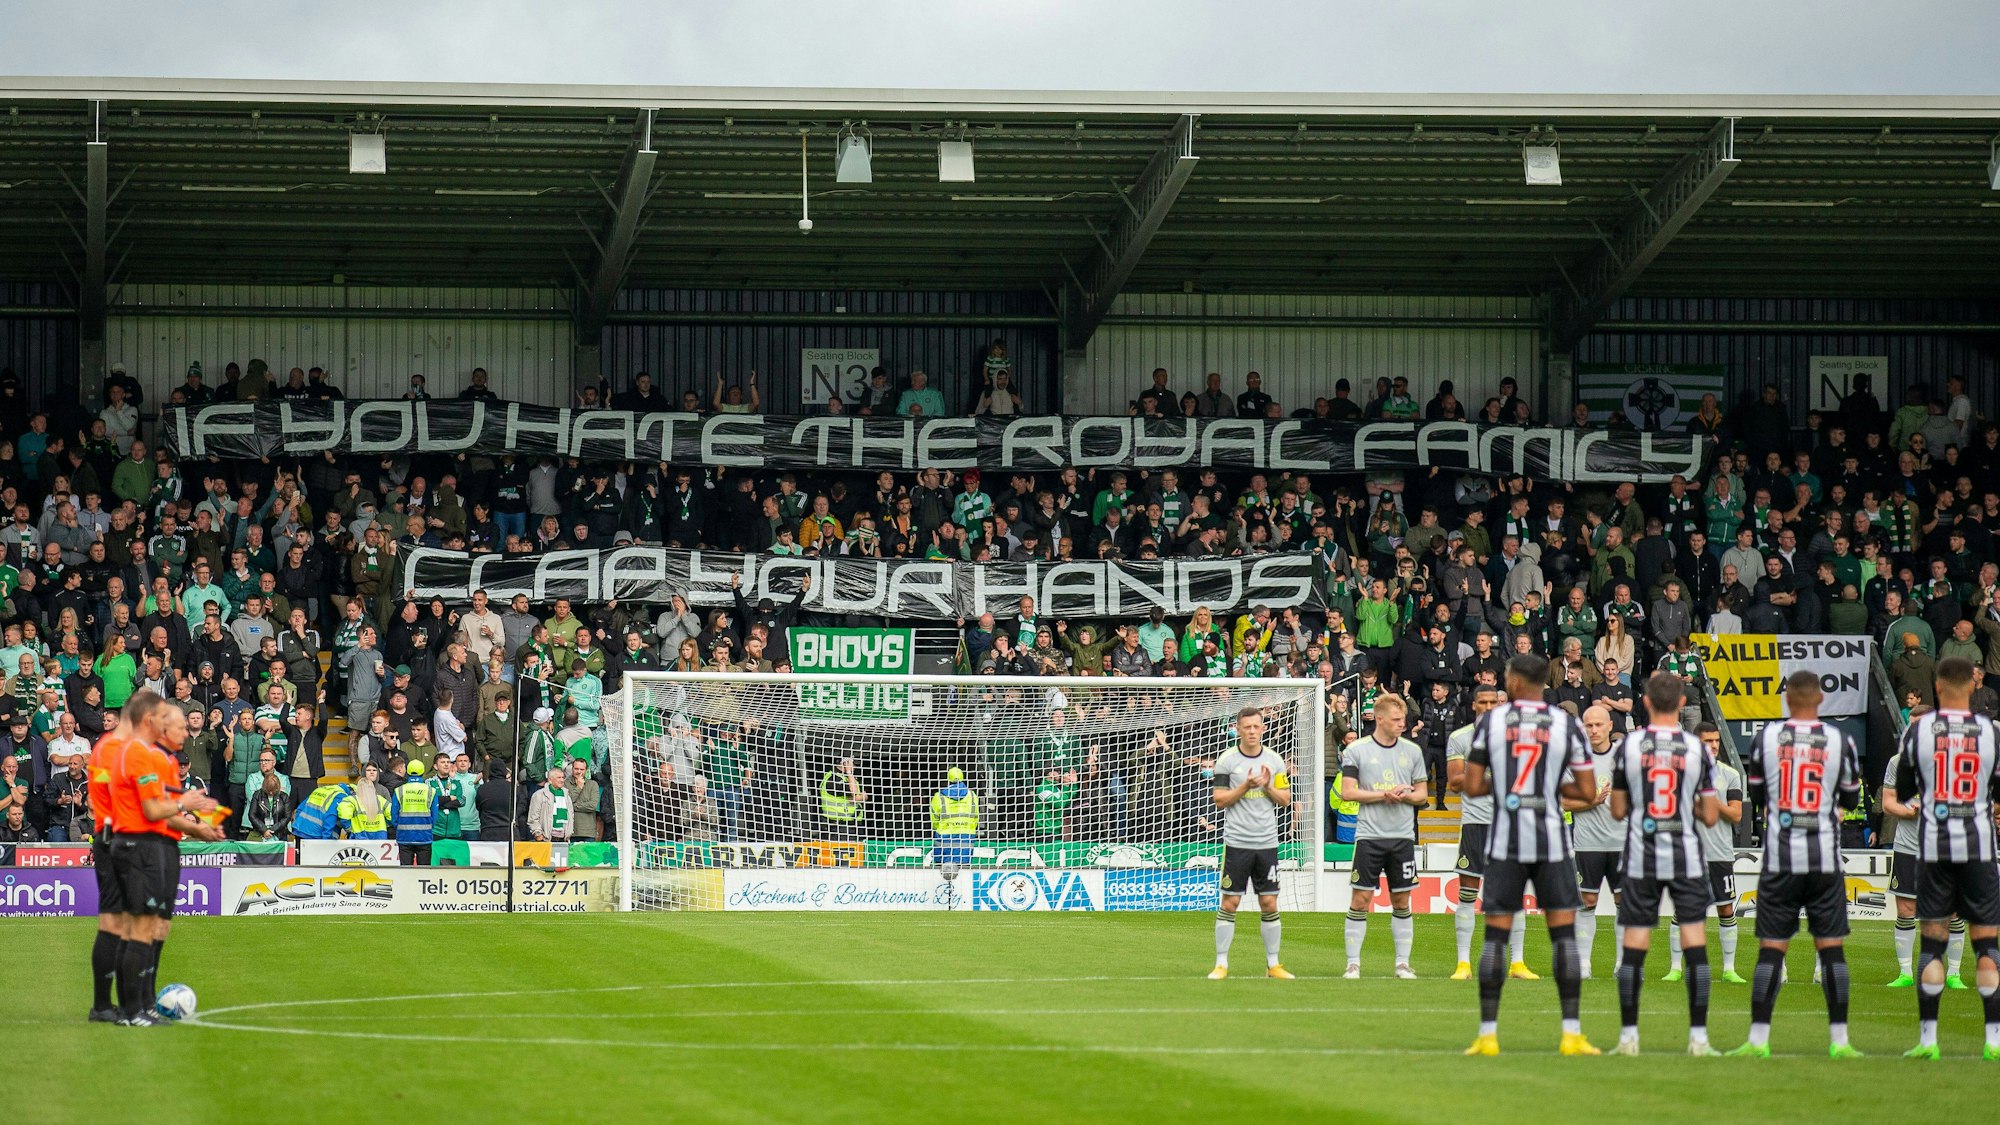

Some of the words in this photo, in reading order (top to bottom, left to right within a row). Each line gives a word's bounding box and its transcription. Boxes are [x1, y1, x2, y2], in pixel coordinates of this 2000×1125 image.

[807, 350, 844, 362] Seating
[847, 351, 874, 360] Block
[1819, 360, 1852, 371] Seating
[1855, 360, 1879, 369] Block
[174, 403, 255, 457] IF
[280, 400, 485, 452] YOU
[505, 402, 764, 466] HATE
[791, 416, 977, 468] THE
[1002, 415, 1331, 469] ROYAL
[1354, 421, 1703, 483] FAMILY
[403, 546, 666, 600] CLAP
[688, 550, 955, 616] YOUR
[973, 555, 1313, 617] HANDS
[796, 633, 905, 669] BHOYS
[1511, 742, 1543, 794] 7
[1777, 758, 1825, 812] 16
[1933, 750, 1982, 801] 18
[1647, 768, 1678, 818] 3
[233, 876, 394, 916] ACRE
[418, 878, 448, 896] Tel:
[522, 880, 588, 896] 327711
[729, 880, 808, 906] Kitchens
[811, 882, 829, 906] &
[834, 881, 930, 906] Bathrooms
[1109, 883, 1146, 896] 0333
[1149, 883, 1176, 896] 355
[1179, 883, 1216, 896] 5225
[272, 904, 300, 915] British
[302, 899, 337, 911] Industry
[339, 900, 362, 909] Since
[365, 901, 388, 909] 1989
